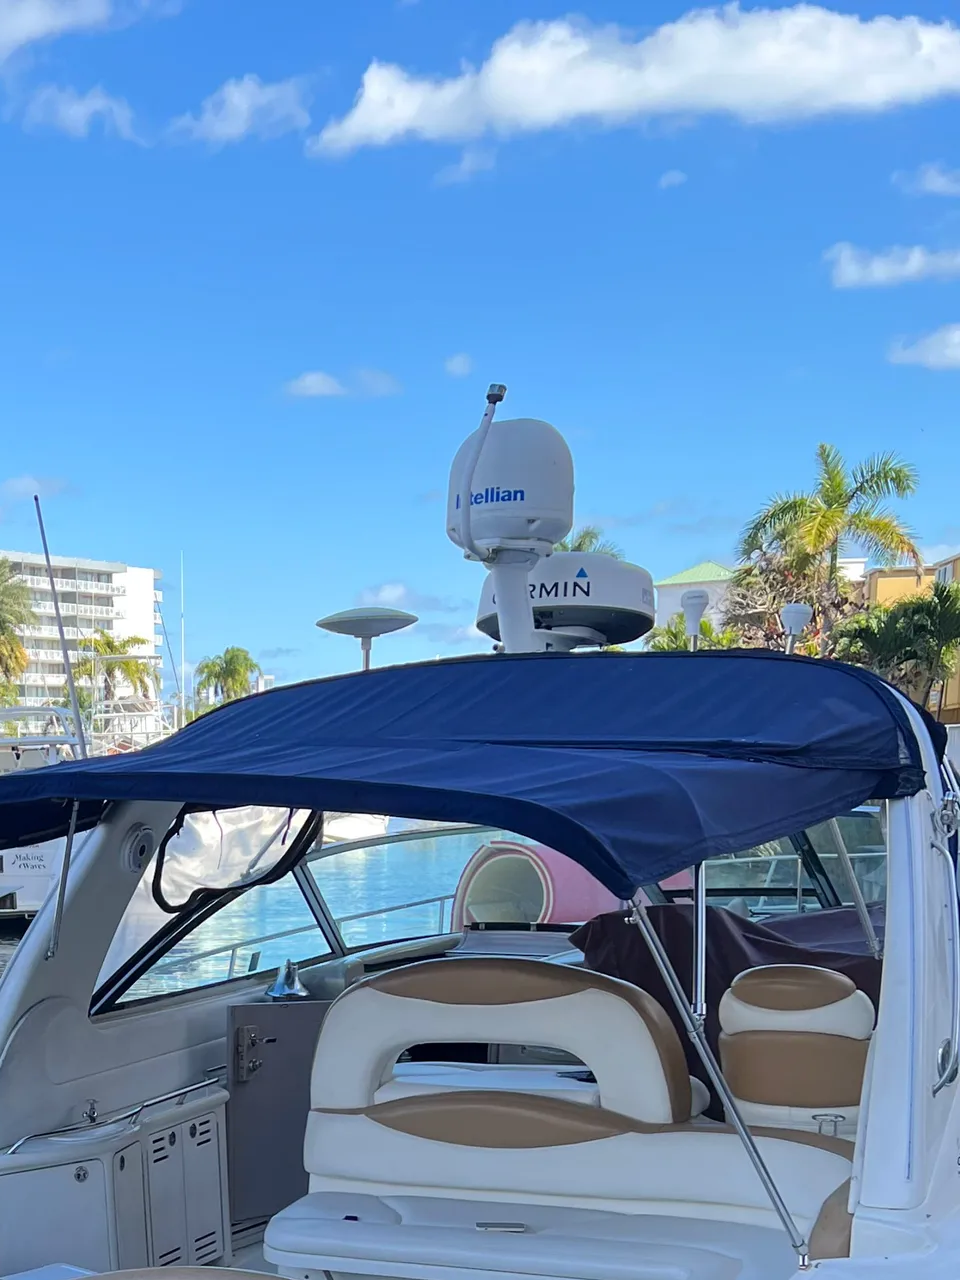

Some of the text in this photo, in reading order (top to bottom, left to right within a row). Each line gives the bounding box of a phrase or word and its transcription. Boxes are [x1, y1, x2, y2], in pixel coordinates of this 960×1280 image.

[456, 487, 525, 509] Itellian
[12, 853, 44, 865] Making
[19, 862, 46, 870] Waves
